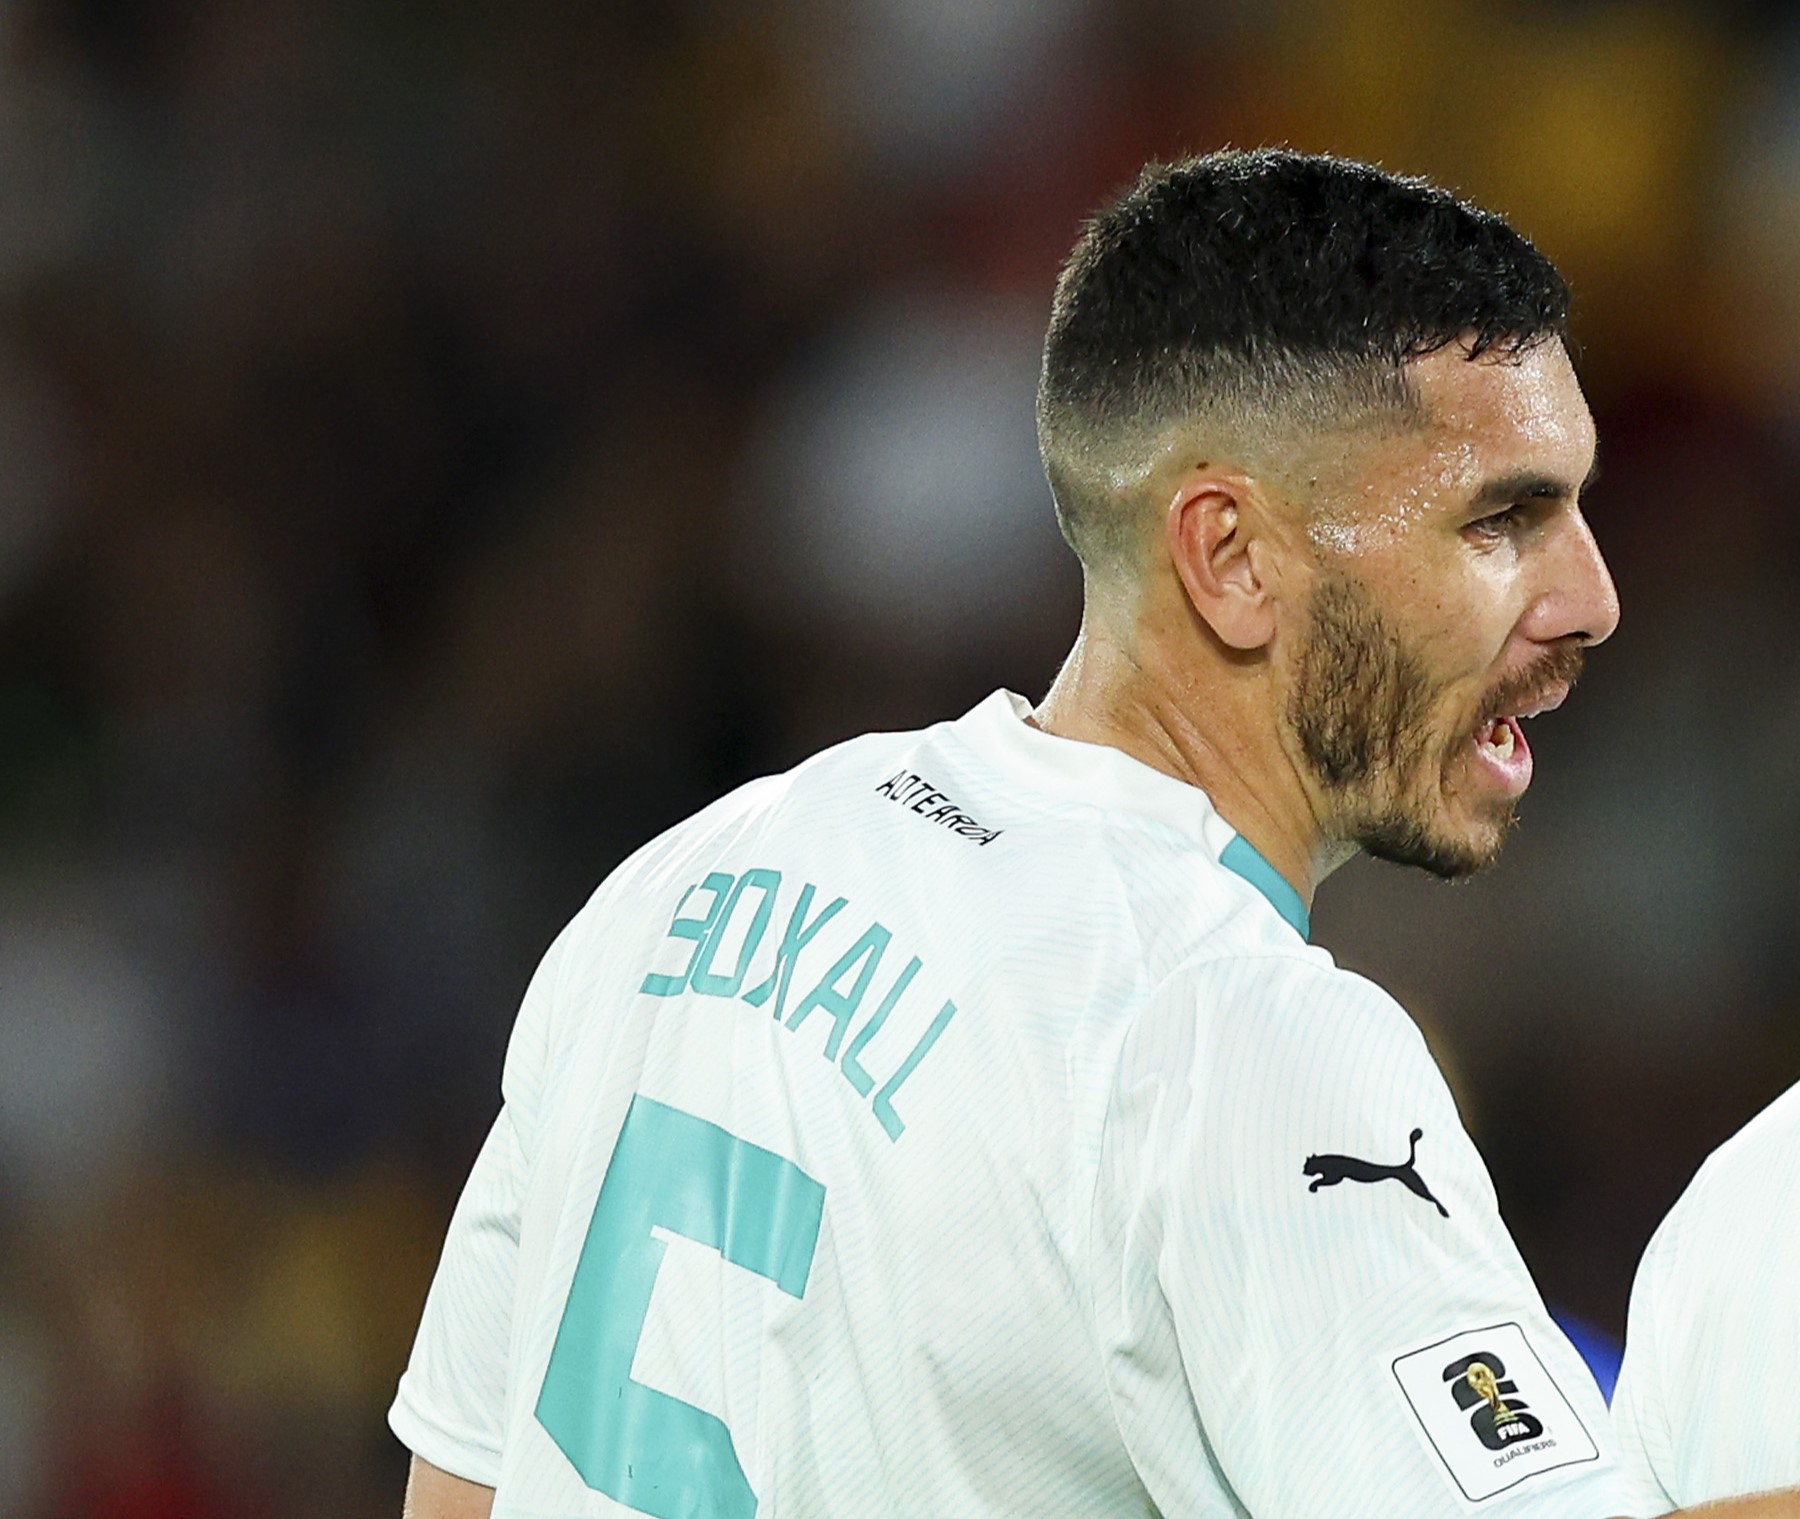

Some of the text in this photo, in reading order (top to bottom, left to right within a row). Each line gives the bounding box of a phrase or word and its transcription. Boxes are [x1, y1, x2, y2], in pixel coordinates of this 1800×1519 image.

[876, 770, 1005, 846] AOTEAROA
[1497, 1422, 1531, 1440] FIFA
[1494, 1440, 1557, 1468] QUALIFIERS
